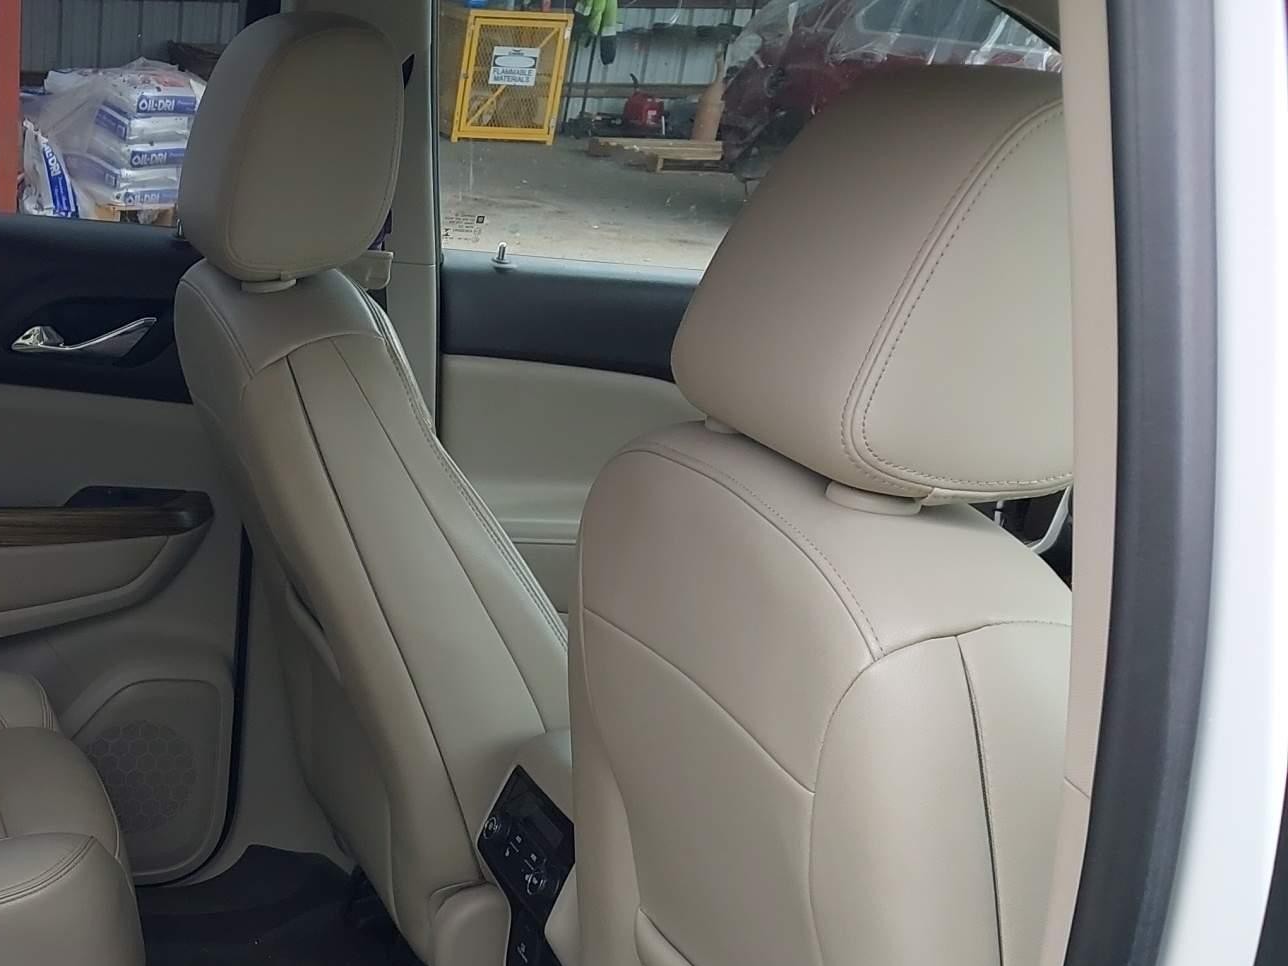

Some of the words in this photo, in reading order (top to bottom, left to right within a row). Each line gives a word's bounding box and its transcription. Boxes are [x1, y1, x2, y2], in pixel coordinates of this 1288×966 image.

[493, 68, 533, 77] FLAMMABLE
[493, 75, 531, 83] MATERIALS
[138, 98, 176, 111] OIL-DRI
